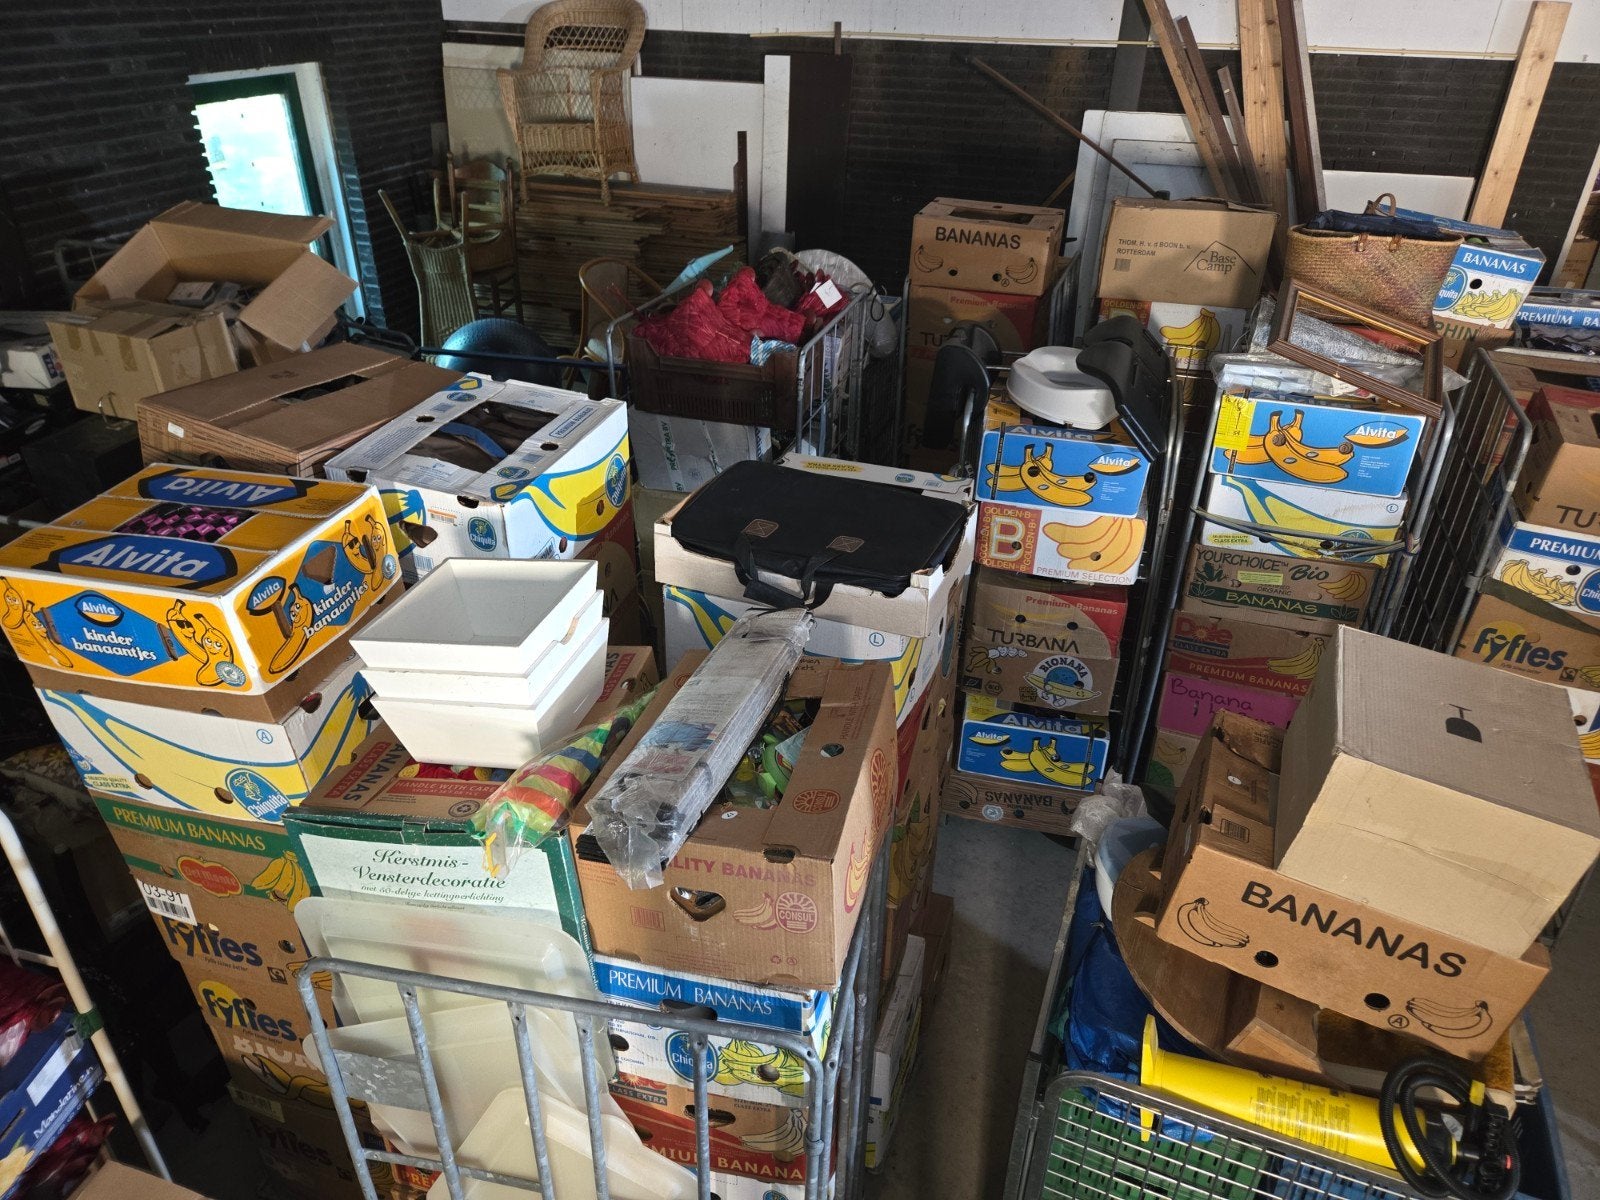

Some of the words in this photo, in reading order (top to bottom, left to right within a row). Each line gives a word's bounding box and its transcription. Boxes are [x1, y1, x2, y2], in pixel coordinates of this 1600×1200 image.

[935, 226, 1021, 250] BANANAS
[1116, 248, 1156, 256] ROTTERDAM
[1210, 250, 1236, 264] Base
[1462, 252, 1528, 274] BANANAS
[1196, 258, 1233, 274] Camp
[1516, 311, 1573, 325] PREMIUM
[1010, 426, 1093, 441] Alvita
[1354, 424, 1397, 440] Alvita
[1096, 456, 1132, 467] Alvita
[162, 475, 286, 505] Alvita
[470, 532, 496, 546] Chiquita
[74, 542, 210, 580] Alvita
[1036, 566, 1080, 580] PREMIUM
[1082, 571, 1132, 584] SELECTION
[1289, 564, 1330, 582] Bio
[250, 580, 282, 607] Alvita
[312, 579, 353, 616] kinder
[1256, 586, 1292, 596] ORGANIC
[81, 600, 116, 616] Alvita
[302, 580, 371, 639] banaantjes
[1026, 595, 1071, 610] Premium
[1076, 602, 1118, 616] Bananas
[1225, 591, 1318, 614] BANANAS
[82, 628, 134, 646] kinder
[987, 628, 1080, 654] TURBANA
[71, 638, 157, 662] banaantjes
[1038, 656, 1089, 678] BIONANA
[1188, 662, 1246, 682] PREMIUM
[1249, 674, 1309, 694] BANANAS
[1171, 678, 1254, 711] Banana
[976, 731, 1004, 740] Alvita
[1002, 714, 1082, 736] Alvita
[363, 742, 391, 770] CLASS
[342, 742, 404, 802] ANANAS
[328, 770, 364, 798] EXTRA
[395, 782, 438, 790] HANDLE
[440, 783, 468, 791] WITH
[247, 793, 292, 819] Chiquita
[984, 790, 1054, 807] BANANAS
[112, 805, 184, 838] PREMIUM
[188, 821, 266, 852] BANANAS
[352, 865, 507, 889] Vensterdecoratie
[669, 854, 716, 874] LITY
[722, 861, 817, 888] BANANAS
[424, 889, 505, 903] kettingverlichting
[780, 910, 815, 923] CONSUL
[1240, 880, 1468, 978] BANANAS
[609, 970, 682, 1000] PREMIUM
[694, 987, 773, 1016] BANANAS
[672, 1052, 714, 1070] Chiqa
[636, 1092, 666, 1104] EXTRA
[718, 1156, 803, 1180] BANANA
